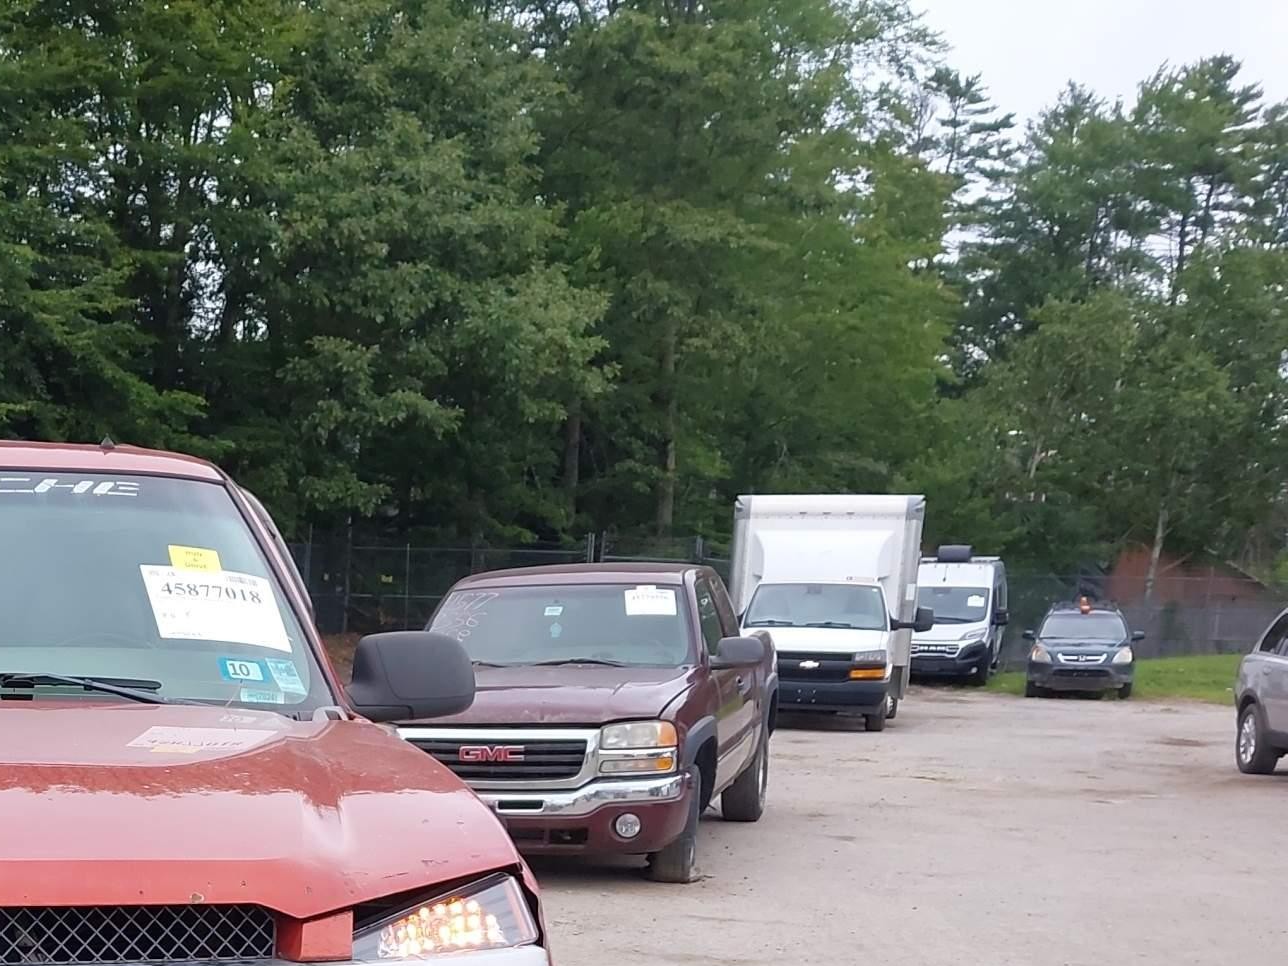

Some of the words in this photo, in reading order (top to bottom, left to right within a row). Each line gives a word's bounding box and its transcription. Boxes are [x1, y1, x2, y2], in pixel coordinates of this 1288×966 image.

[161, 582, 262, 604] 45877018
[228, 662, 250, 677] 10
[459, 745, 525, 761] GMC
